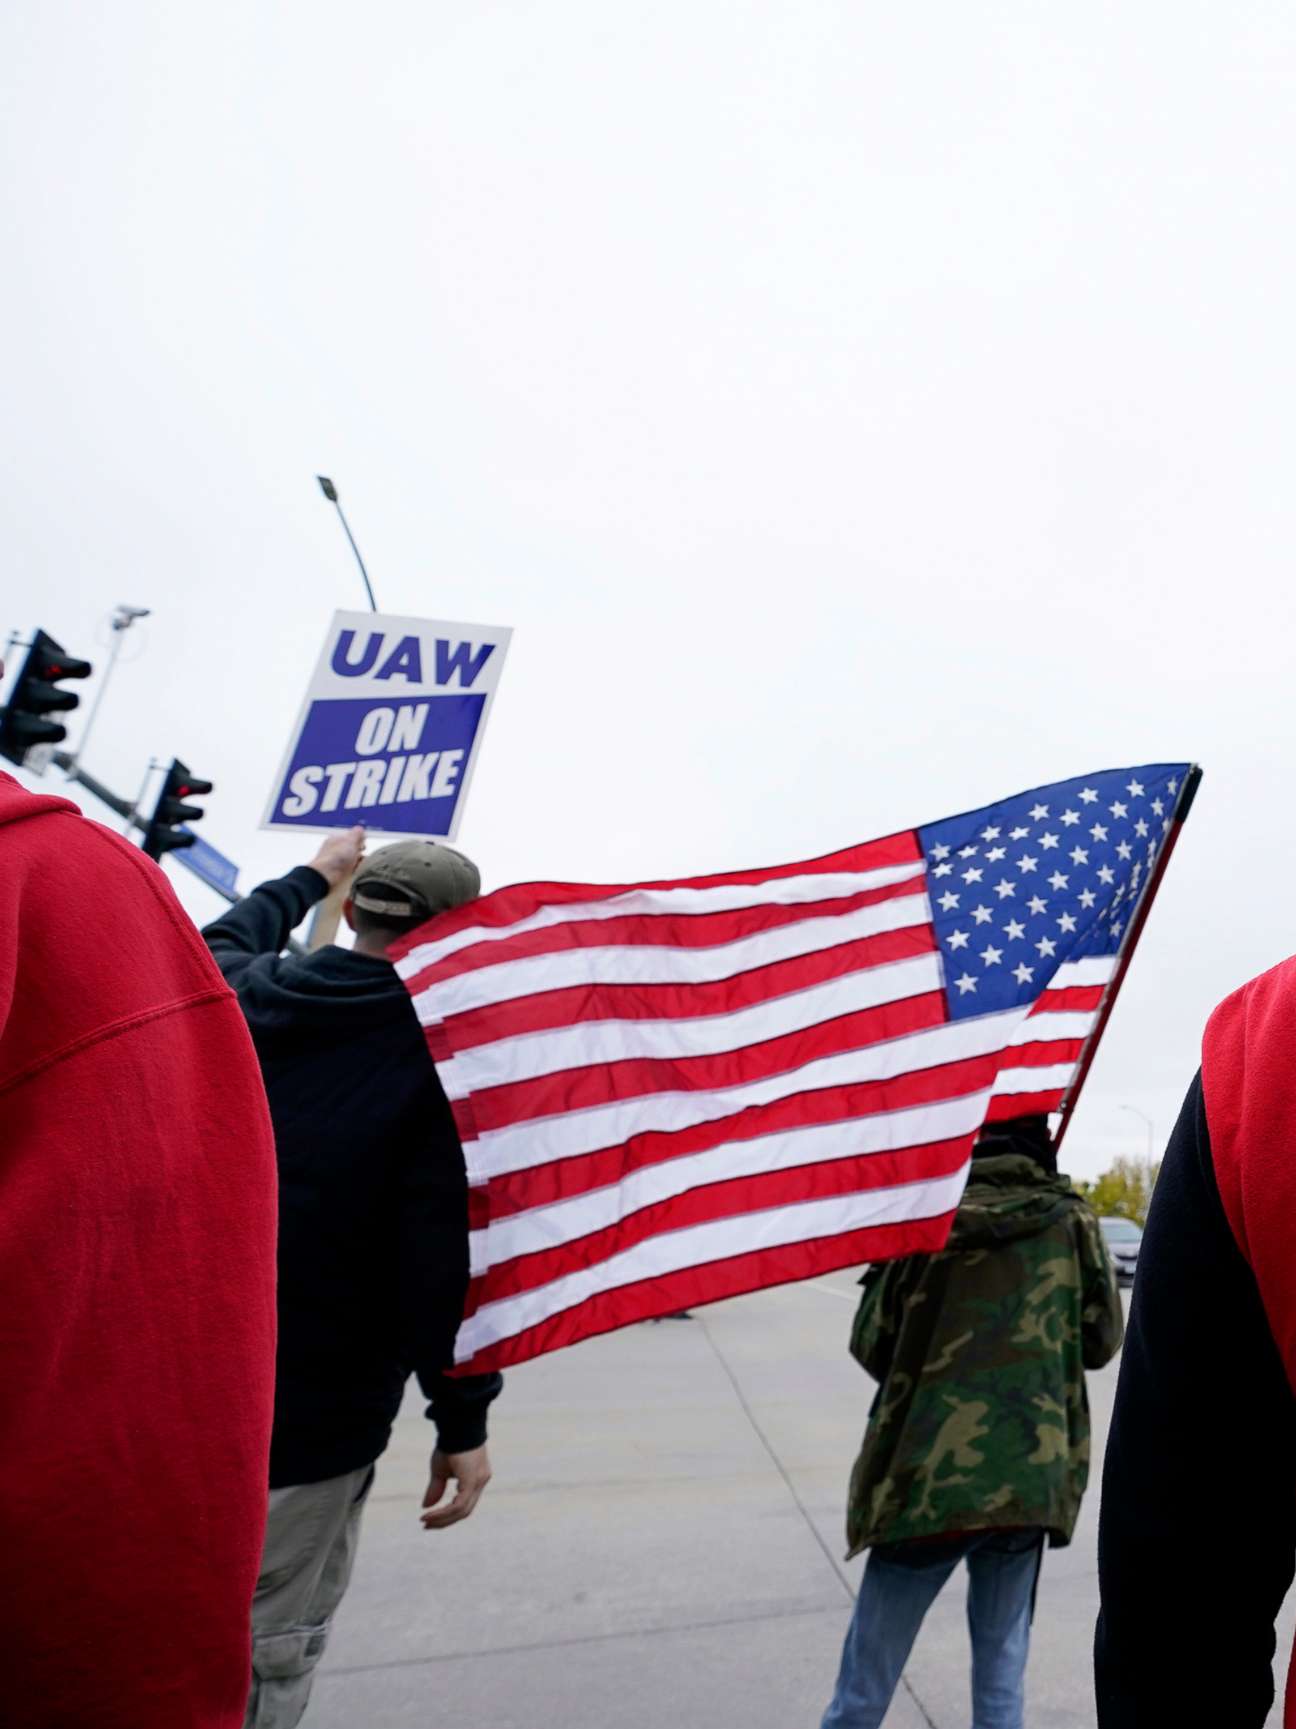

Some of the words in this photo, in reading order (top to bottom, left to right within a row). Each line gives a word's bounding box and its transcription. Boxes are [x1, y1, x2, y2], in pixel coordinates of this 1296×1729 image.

[330, 629, 497, 688] UAW
[354, 703, 430, 756] ON
[281, 749, 465, 817] STRIKE
